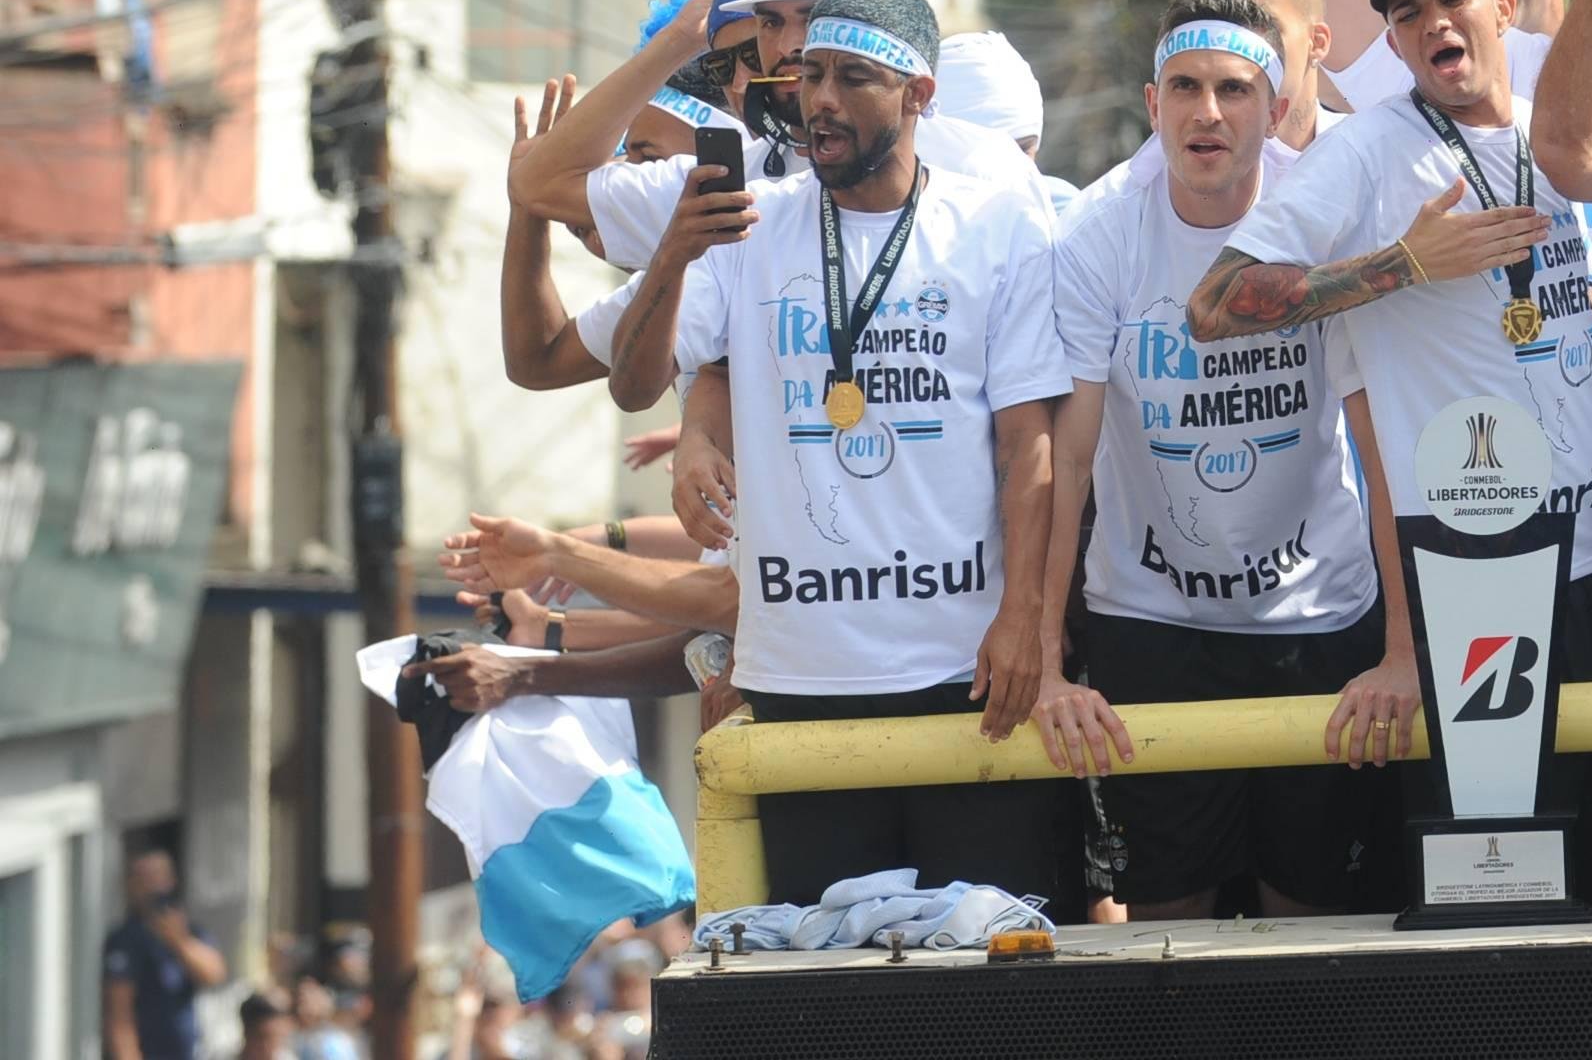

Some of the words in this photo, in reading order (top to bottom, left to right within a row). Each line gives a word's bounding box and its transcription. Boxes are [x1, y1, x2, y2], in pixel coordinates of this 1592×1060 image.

[1203, 341, 1307, 379] CAMPEÃO
[1564, 343, 1589, 369] 2017
[782, 379, 814, 414] DA
[1140, 400, 1172, 431] DA
[1180, 379, 1309, 428] AMÉRICA
[844, 434, 885, 458] 2017
[1205, 450, 1247, 474] 2017
[1464, 475, 1503, 485] CONMEBOL
[1428, 487, 1539, 501] LIBERTADORES
[1454, 507, 1515, 516] BRIDGESTONE
[757, 541, 986, 604] Banrisul
